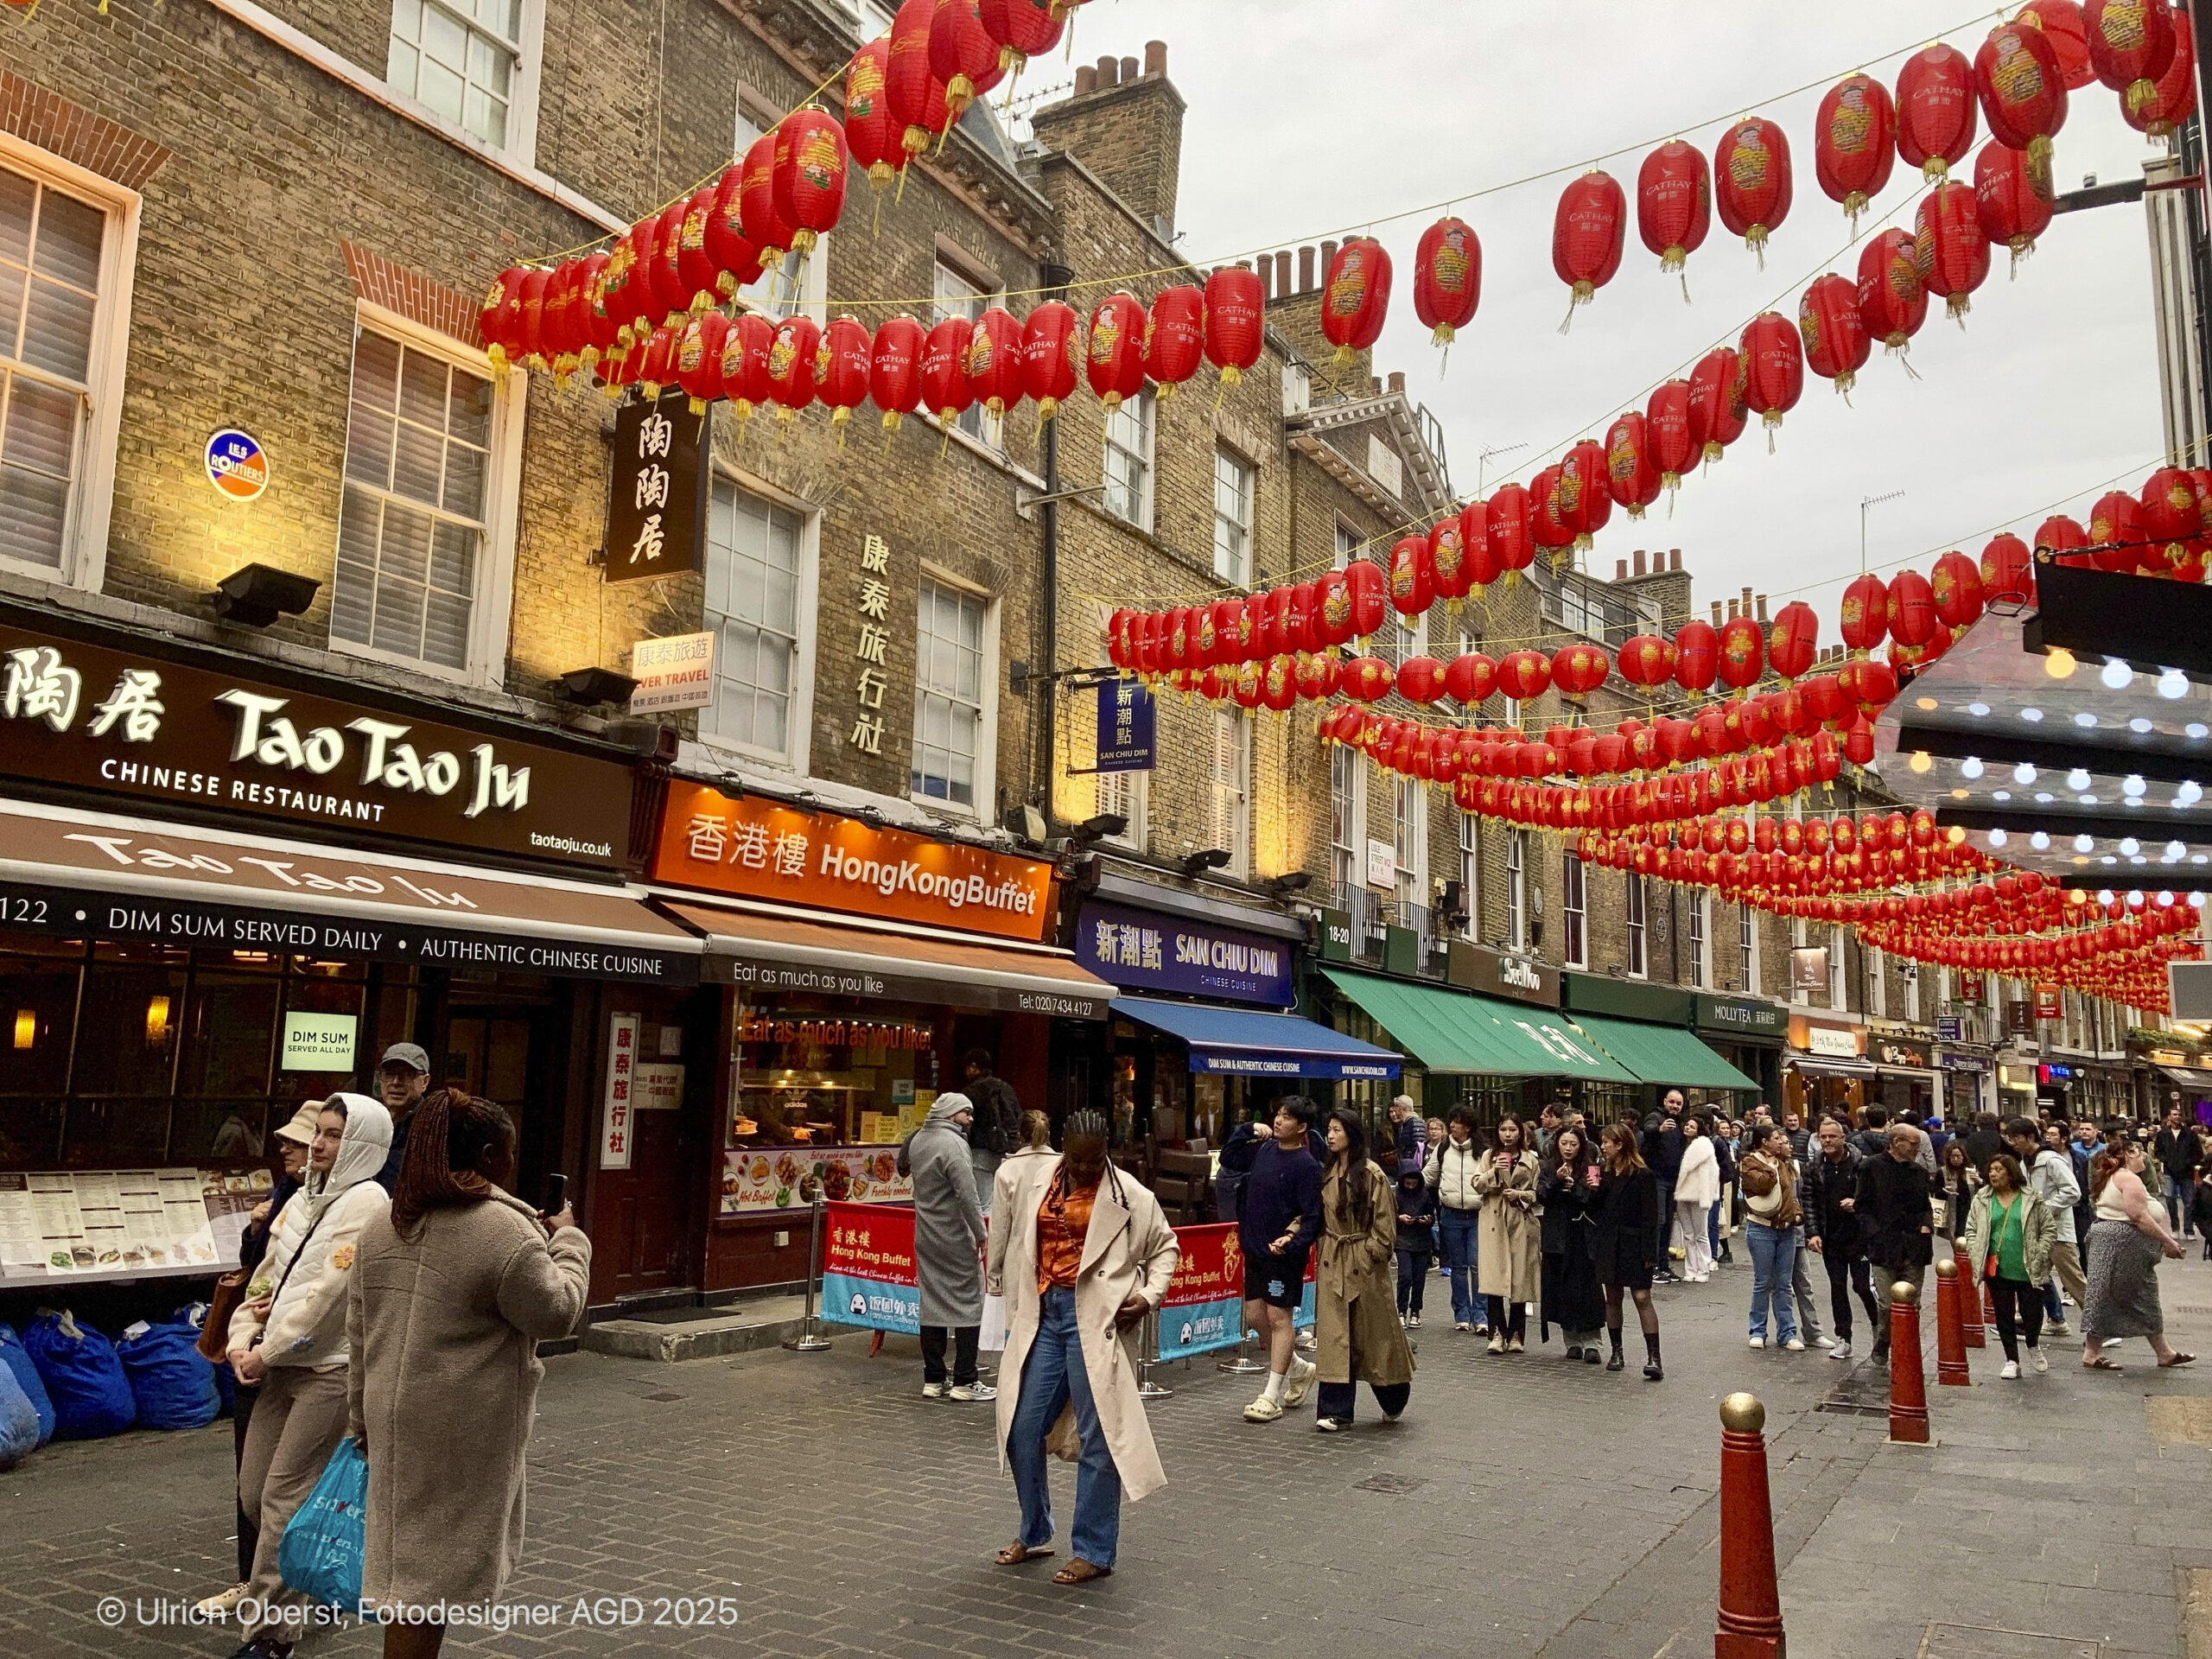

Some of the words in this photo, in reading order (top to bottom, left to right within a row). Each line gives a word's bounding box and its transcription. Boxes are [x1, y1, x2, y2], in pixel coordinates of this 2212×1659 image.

[1913, 85, 1966, 99] CATHAY
[1646, 180, 1691, 196] CATHAY
[1569, 211, 1614, 224] CATHAY
[1217, 306, 1257, 319] CATHAY
[1832, 312, 1860, 321] CATH
[753, 348, 768, 359] CAT
[1005, 344, 1021, 358] CAT
[1023, 340, 1058, 354] CATHAY
[875, 353, 910, 364] CATHAY
[228, 442, 247, 460] LES
[212, 454, 264, 482] ROUTIERS
[630, 413, 672, 564] 陶陶居
[1490, 520, 1521, 532] CATHAY
[639, 637, 709, 666] 康泰旅遊
[850, 534, 890, 754] 康泰旅行社
[637, 675, 662, 690] VER
[665, 670, 709, 684] TRAVEL
[1116, 689, 1133, 746] 新潮點
[214, 689, 344, 774] Tao
[345, 716, 461, 797] Tao
[464, 743, 531, 818] Ju
[1134, 748, 1148, 757] DIM
[101, 759, 219, 797] CHINESE
[232, 781, 385, 823] RESTAURANT
[531, 830, 612, 857] taotaoju.co.uk
[689, 812, 810, 879] 香港樓
[62, 833, 233, 874] Tao
[238, 856, 385, 894] Tao
[391, 875, 479, 910] Ju
[109, 908, 162, 932] DIM
[170, 914, 225, 938] SUM
[233, 919, 316, 946] SERVED
[324, 928, 383, 951] DAILY
[420, 938, 525, 964] AUTHENTIC
[530, 948, 599, 970] CHINESE
[603, 955, 663, 976] CUISINE
[1329, 925, 1349, 944] 18-20
[1096, 919, 1162, 971] 新潮點
[1176, 933, 1210, 966] SAN
[1211, 940, 1249, 973] CHIU
[1250, 948, 1278, 977] DIM
[734, 963, 758, 981] Eat
[761, 969, 777, 983] as
[780, 970, 818, 988] much
[822, 975, 836, 988] as
[839, 977, 861, 994] you
[865, 976, 884, 994] like
[1200, 975, 1229, 988] CHINESE
[1231, 979, 1256, 992] CUISINE
[1019, 995, 1034, 1009] Tel:
[1035, 995, 1052, 1011] 020
[1052, 998, 1072, 1014] 7434
[1074, 1001, 1092, 1015] 4127
[293, 1031, 317, 1043] DIM
[321, 1033, 348, 1044] SUM
[741, 1011, 772, 1042] Eat
[775, 1021, 795, 1043] as
[799, 1019, 846, 1046] much
[849, 1023, 868, 1048] as
[871, 1026, 899, 1057] you
[1208, 1058, 1218, 1068] DIM
[1219, 1058, 1231, 1069] SUM
[1231, 1059, 1236, 1069] &
[1236, 1060, 1263, 1071] AUTHENTIC
[1263, 1061, 1282, 1071] CHINESE
[1283, 1063, 1300, 1072] CUISINE
[609, 1027, 632, 1153] 康泰旅行社
[739, 1190, 751, 1203] Hot
[752, 1190, 776, 1205] Buffet
[833, 1227, 870, 1248] 香港樓
[831, 1244, 854, 1260] Hong
[857, 1249, 880, 1264] Kong
[882, 1253, 911, 1267] Buffet
[1171, 1277, 1184, 1288] ong
[1185, 1274, 1201, 1286] Kong
[1203, 1271, 1220, 1282] Buffet
[869, 1295, 919, 1318] 饭团外卖
